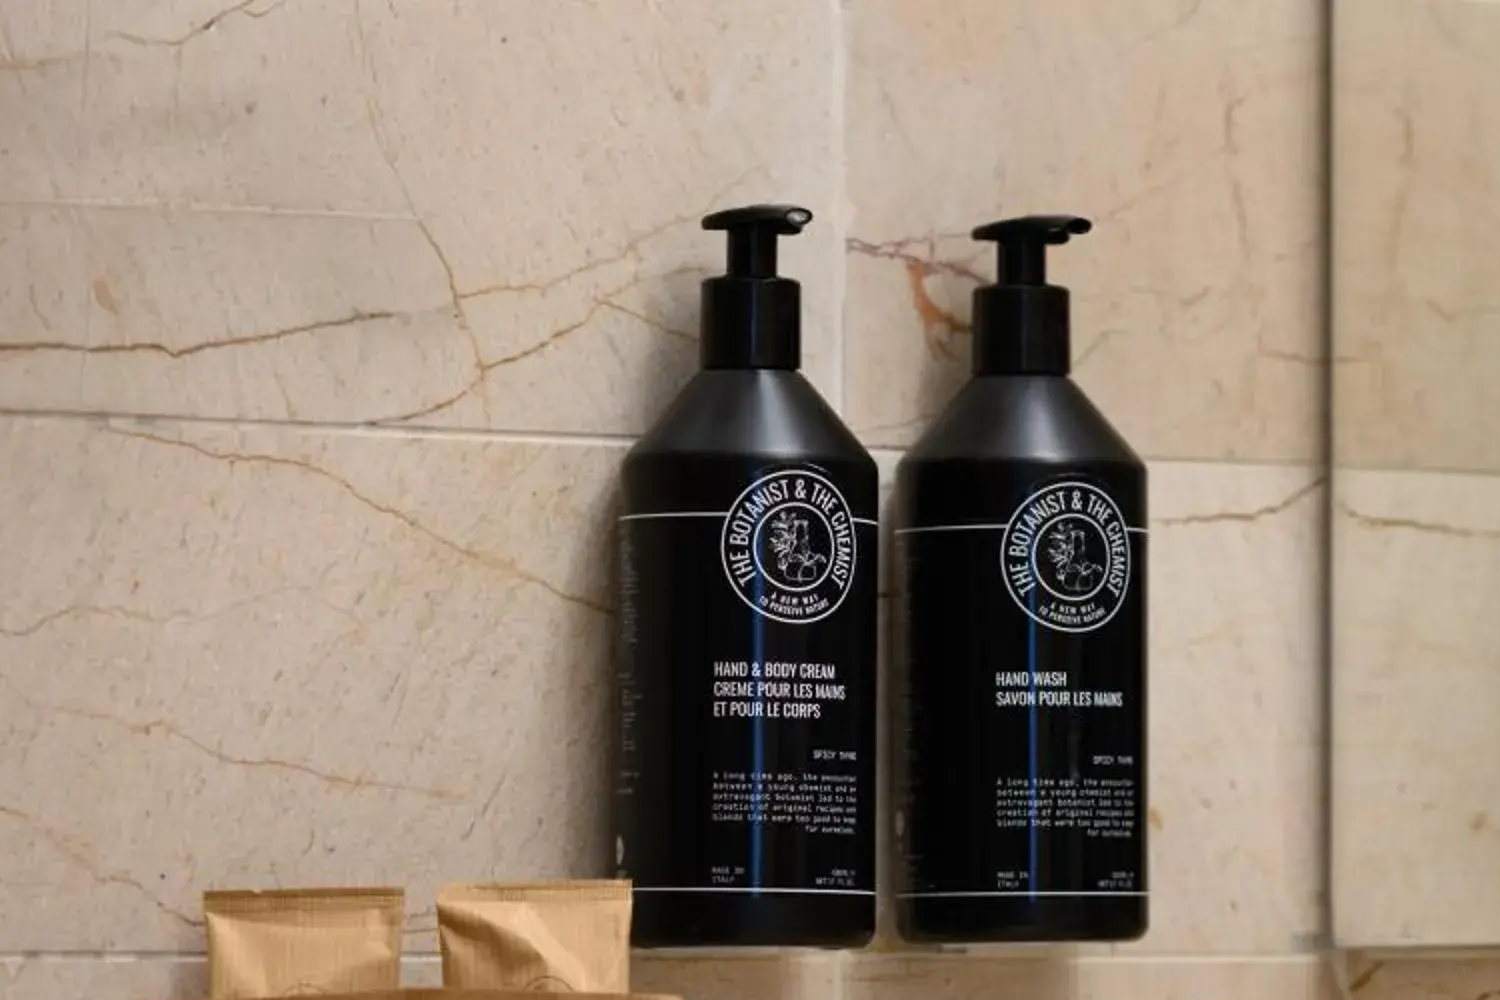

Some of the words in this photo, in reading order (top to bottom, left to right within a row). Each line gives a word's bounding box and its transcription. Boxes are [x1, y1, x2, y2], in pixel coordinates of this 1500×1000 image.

[795, 479, 807, 499] &
[811, 482, 840, 515] THE
[1071, 489, 1082, 511] &
[730, 479, 789, 545] BOTANIST
[1008, 491, 1066, 557] BOTANIST
[1087, 494, 1113, 526] THE
[831, 511, 851, 590] CHEMIST
[1106, 522, 1125, 598] CHEMIST
[730, 549, 757, 587] THE
[1009, 560, 1036, 597] THE
[713, 661, 748, 677] HAND
[751, 662, 761, 677] &
[764, 662, 797, 678] BODY
[800, 663, 835, 679] CREAM
[995, 671, 1029, 687] HAND
[1032, 671, 1067, 687] WASH
[757, 682, 791, 698] POUR
[793, 684, 813, 699] LES
[815, 684, 846, 700] MAINS
[995, 691, 1036, 707] SAVON
[1039, 691, 1071, 707] POUR
[1073, 691, 1093, 707] LES
[1094, 691, 1123, 707] MAINS
[713, 701, 726, 717] ET
[729, 701, 763, 717] POUR
[767, 702, 780, 718] LE
[783, 703, 821, 719] CORPS
